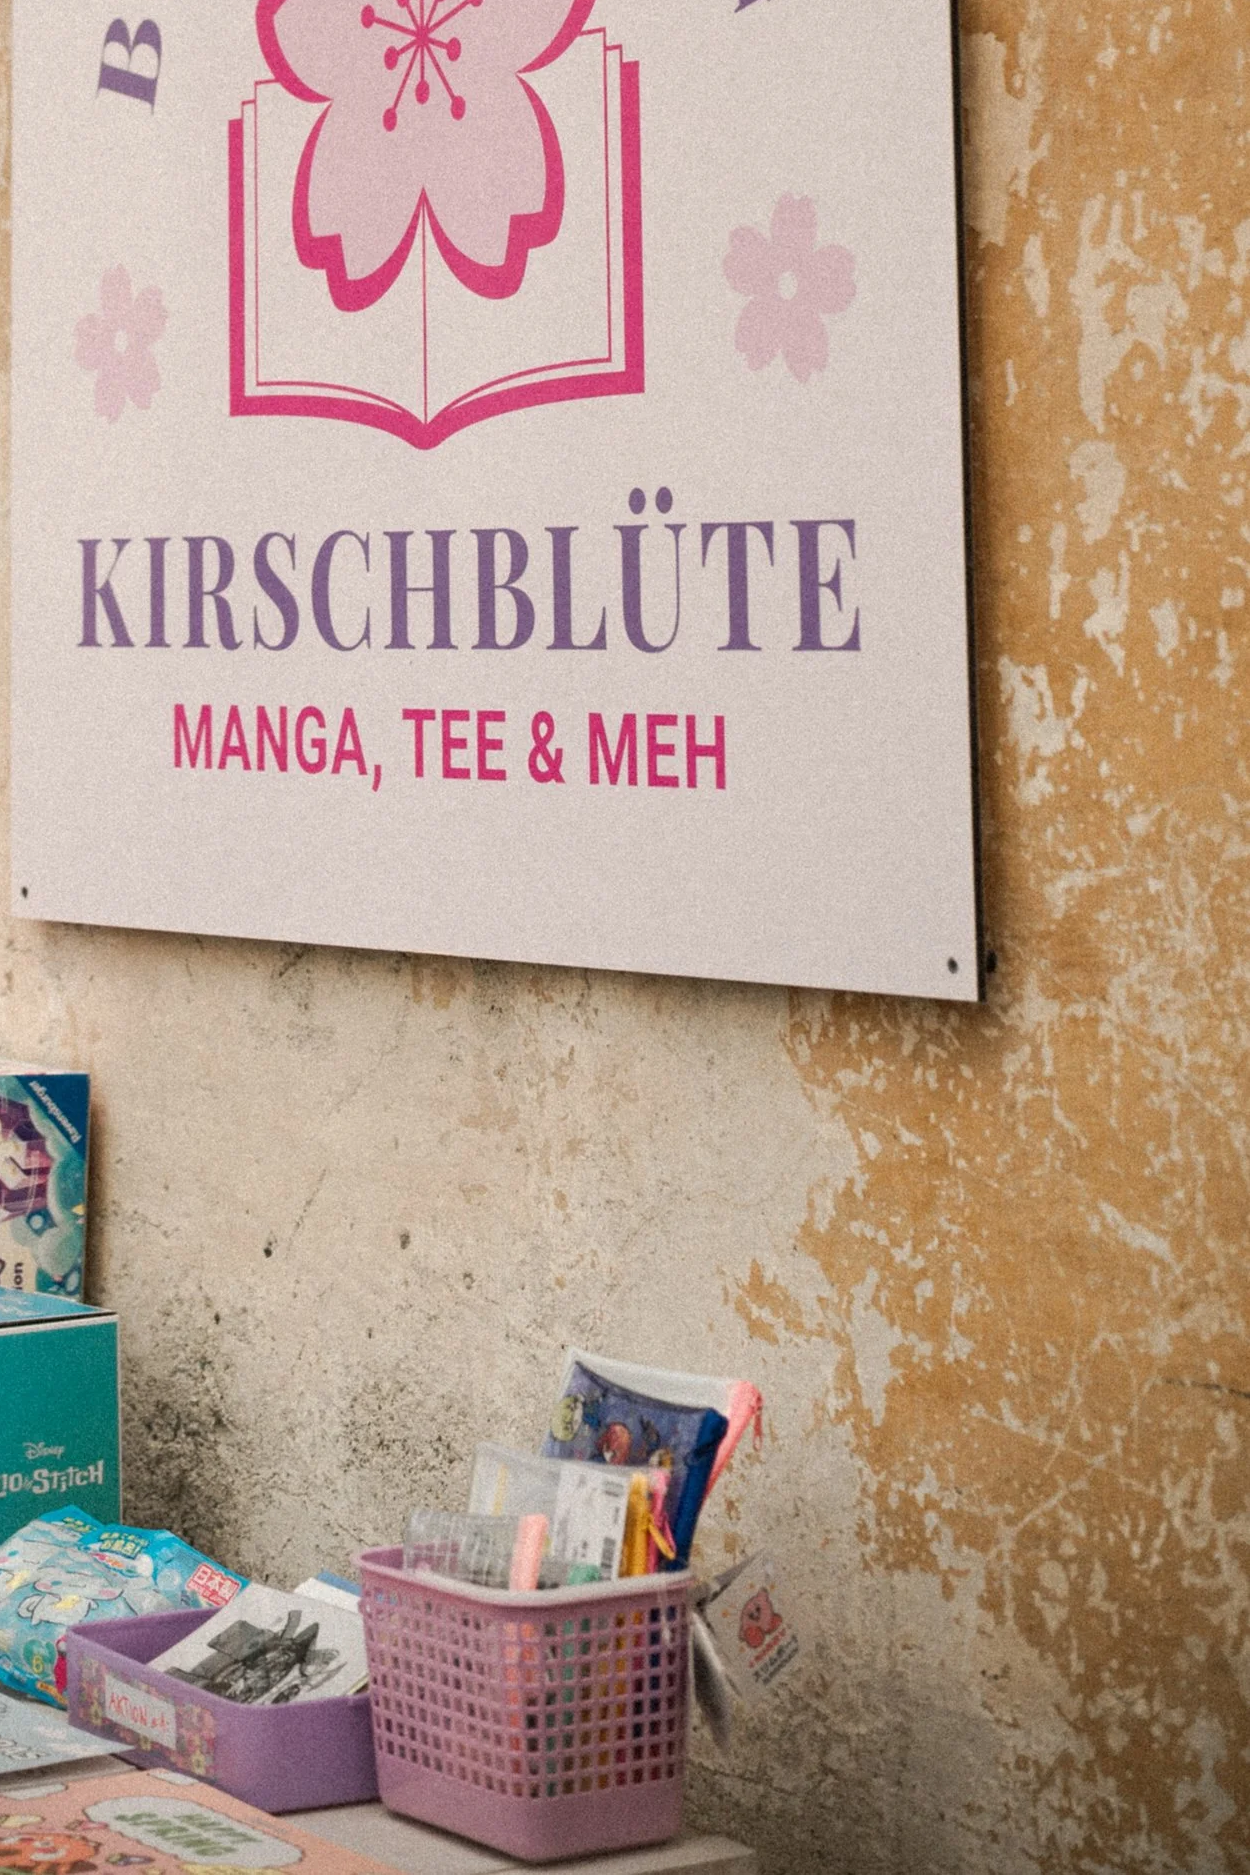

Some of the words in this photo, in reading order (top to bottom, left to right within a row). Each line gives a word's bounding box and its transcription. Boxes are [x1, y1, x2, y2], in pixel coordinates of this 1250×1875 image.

[77, 485, 862, 654] KIRSCHBLÜTE
[172, 703, 383, 792] MANGA,
[401, 707, 507, 781] TEE
[527, 709, 565, 784] &
[587, 712, 727, 790] MEH
[22, 1441, 65, 1460] Disney
